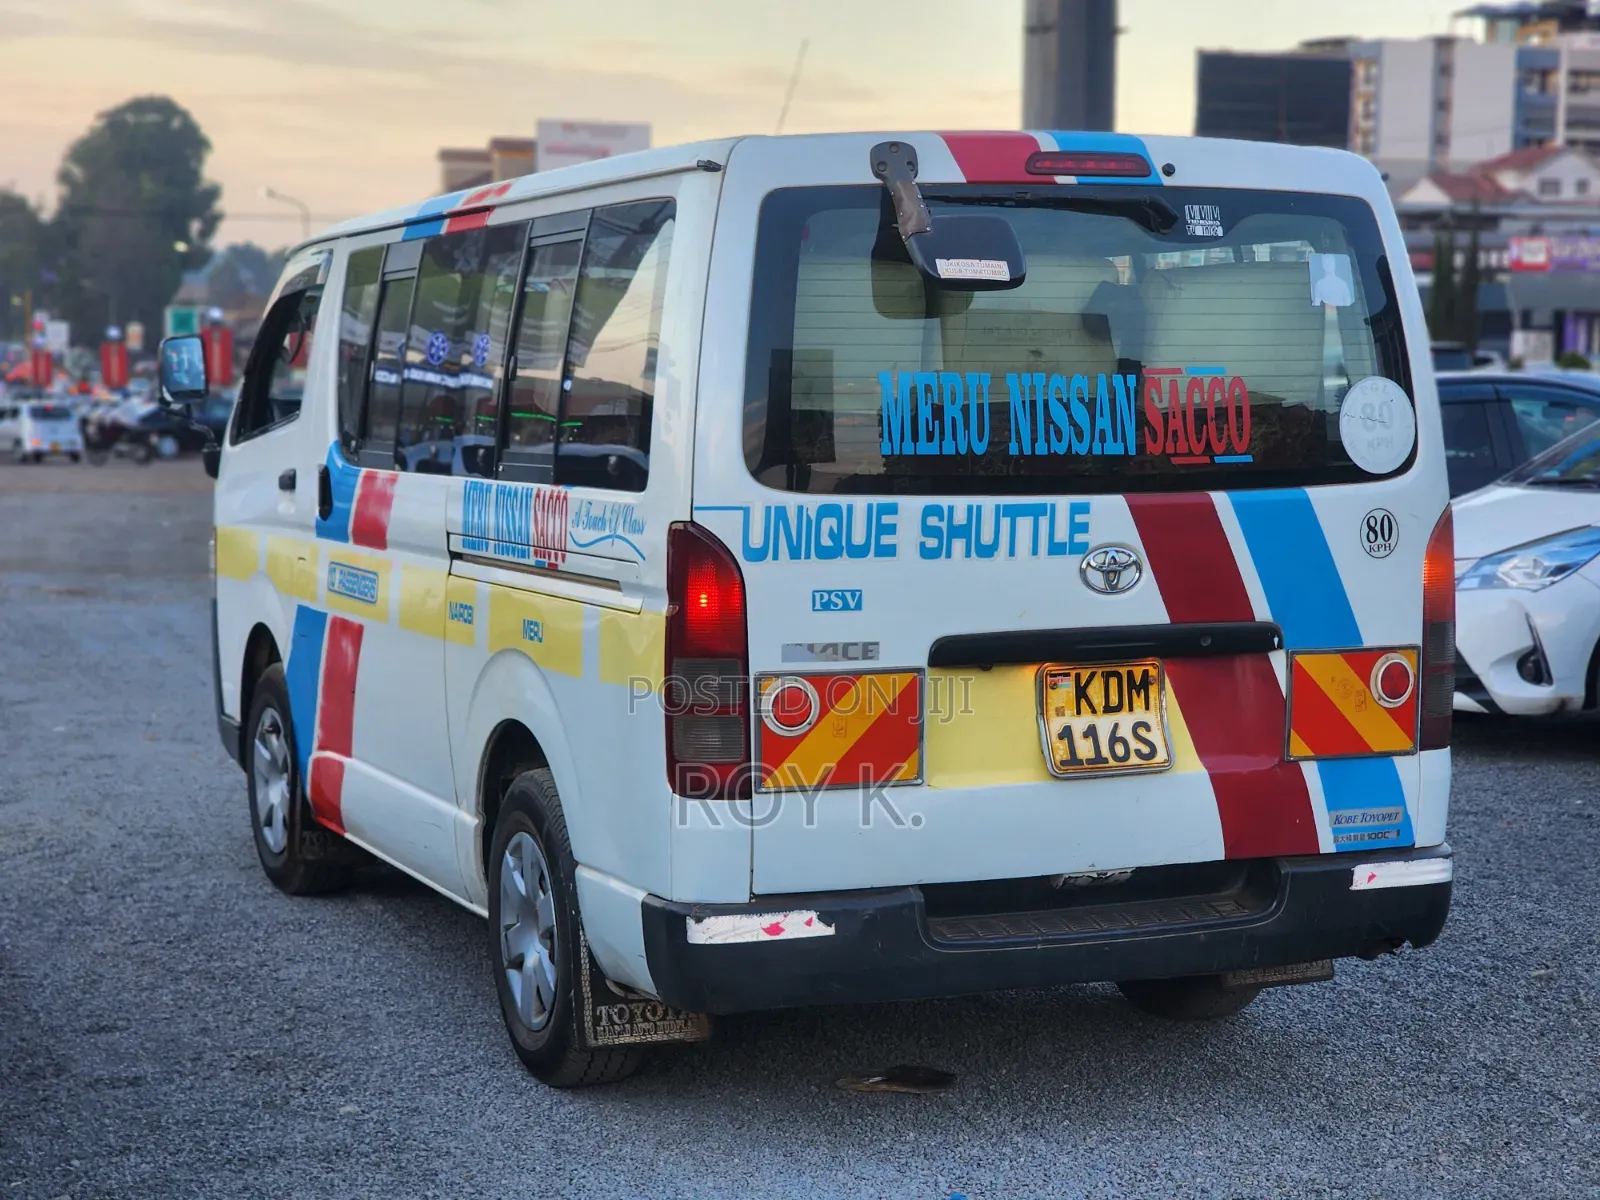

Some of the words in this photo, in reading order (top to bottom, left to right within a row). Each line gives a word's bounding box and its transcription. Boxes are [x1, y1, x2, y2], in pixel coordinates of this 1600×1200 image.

[877, 371, 991, 456] MERU
[1004, 372, 1137, 456] NISSAN
[1143, 375, 1252, 457] SACCO
[462, 480, 493, 553] MERU
[493, 483, 534, 561] NISSAN
[533, 487, 568, 565] SACCO
[741, 502, 898, 563] UNIQUE
[919, 502, 1092, 560] SHUTTLE
[1366, 514, 1393, 544] 80
[1369, 542, 1392, 553] KPH
[448, 600, 474, 625] NAIROBI
[812, 590, 861, 610] PSV
[522, 618, 544, 644] MERU
[785, 641, 880, 661] ACE
[1074, 669, 1150, 716] KDM
[1057, 720, 1158, 767] 116S
[1333, 814, 1360, 826] KOBE
[1360, 811, 1401, 823] TOYOPET
